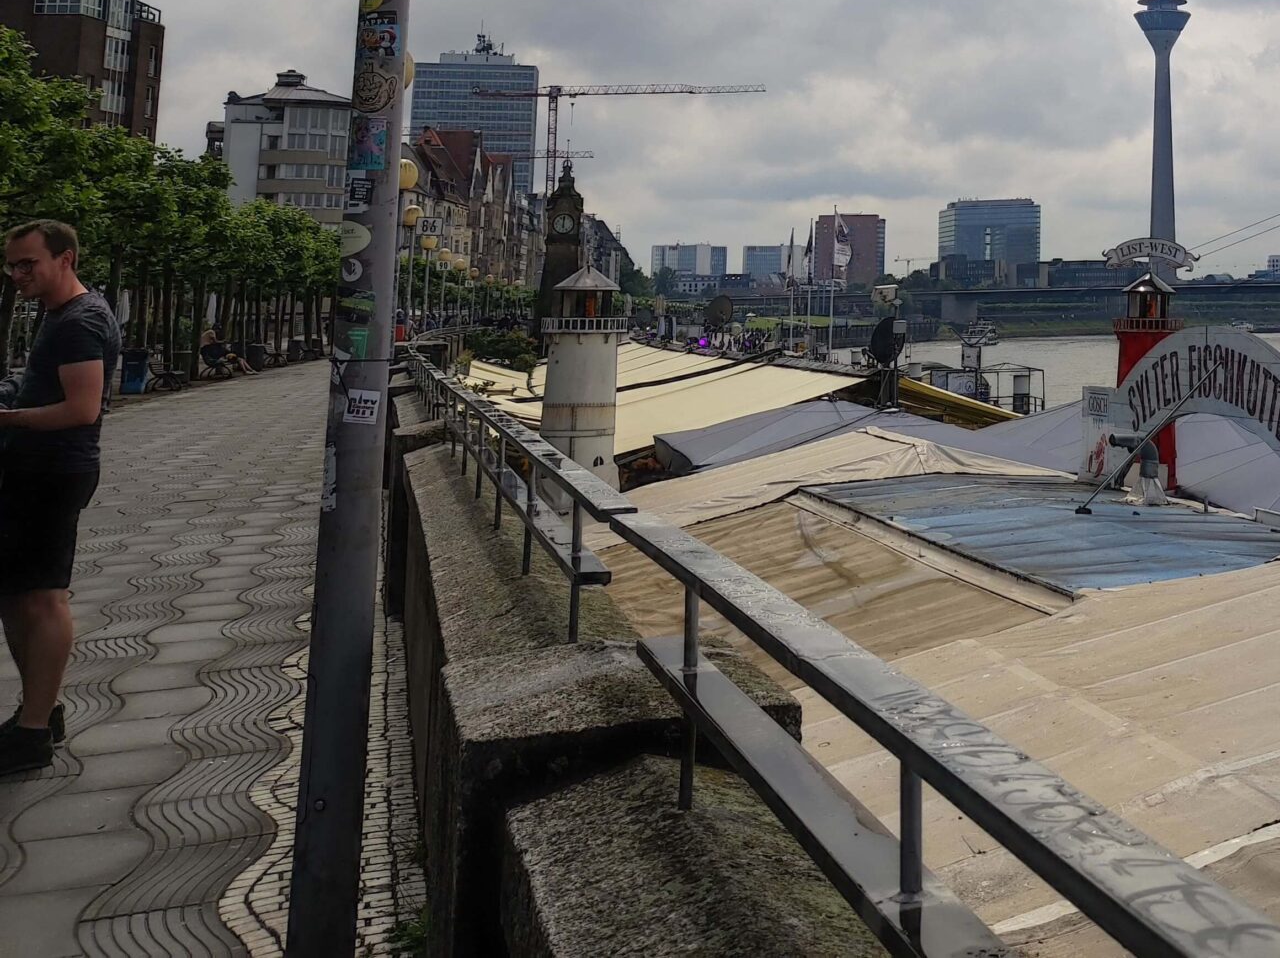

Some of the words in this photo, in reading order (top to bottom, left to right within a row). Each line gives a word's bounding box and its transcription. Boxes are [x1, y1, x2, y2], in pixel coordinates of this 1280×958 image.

[422, 219, 437, 233] 86
[1120, 242, 1180, 258] LIST-WEST
[439, 260, 448, 270] 90
[1127, 350, 1182, 432] SYLTER
[1088, 395, 1108, 414] GOSCH
